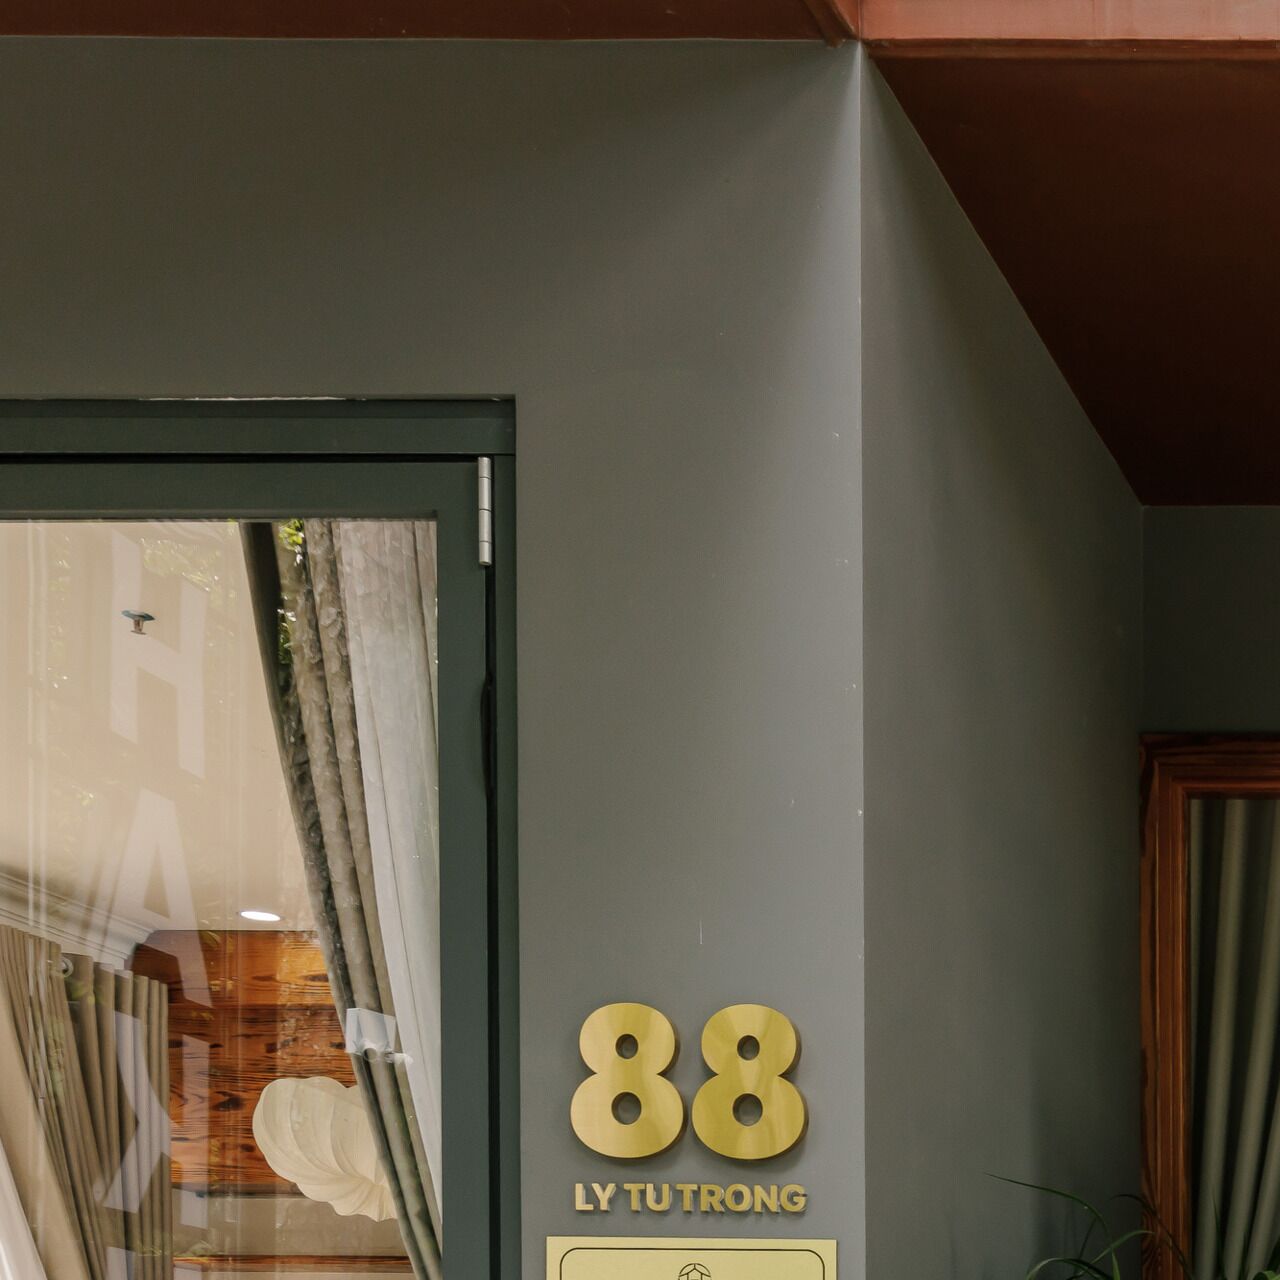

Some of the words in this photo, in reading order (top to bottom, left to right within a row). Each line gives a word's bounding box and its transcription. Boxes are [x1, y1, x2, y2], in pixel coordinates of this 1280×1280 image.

[570, 1002, 809, 1160] 88
[575, 1183, 616, 1212] LY
[623, 1183, 672, 1213] TU
[676, 1183, 808, 1213] TRONG
